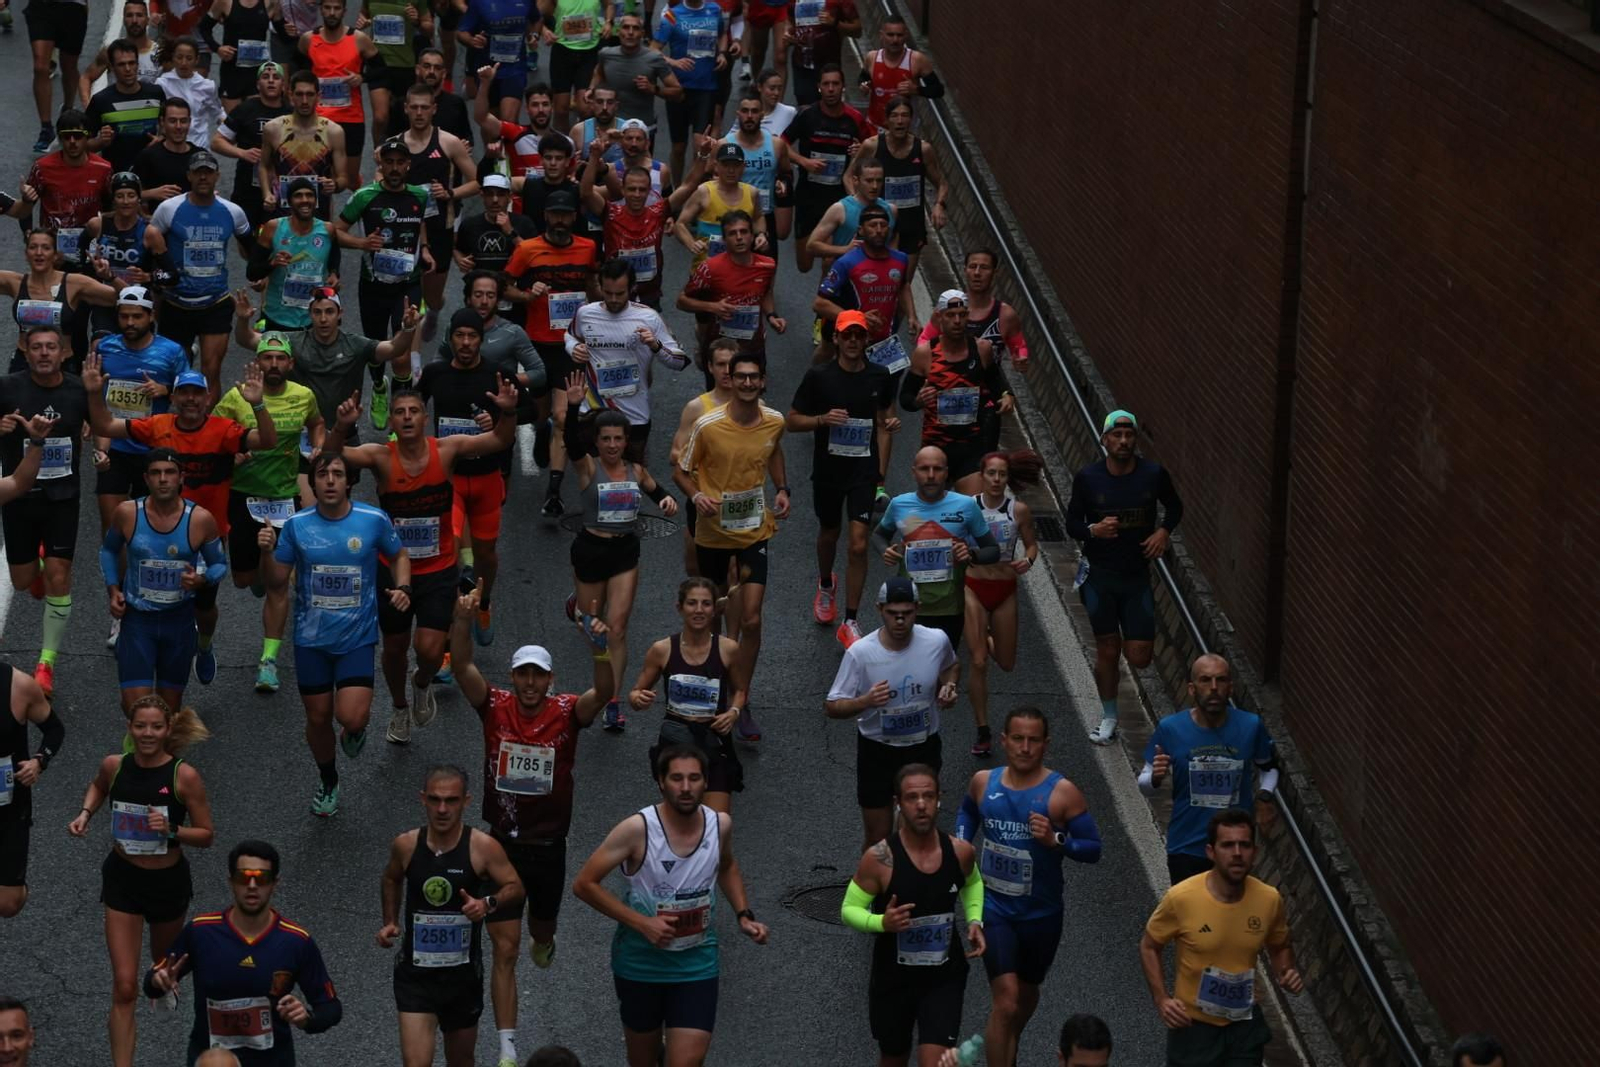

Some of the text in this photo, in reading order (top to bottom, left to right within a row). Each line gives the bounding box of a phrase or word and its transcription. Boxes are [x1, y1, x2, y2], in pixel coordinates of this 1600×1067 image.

[743, 157, 771, 170] erja
[190, 250, 215, 262] 2515
[630, 257, 649, 269] 710
[603, 369, 630, 382] 2562
[110, 389, 144, 406] 13537
[838, 426, 862, 437] 1761
[255, 503, 283, 515] 3367
[912, 550, 941, 564] 3187
[148, 569, 176, 584] 3111
[319, 576, 349, 589] 1957
[509, 755, 540, 773] 1785
[1199, 773, 1232, 788] 3181
[990, 856, 1019, 876] 1513
[421, 928, 456, 944] 2581
[907, 926, 943, 945] 2624
